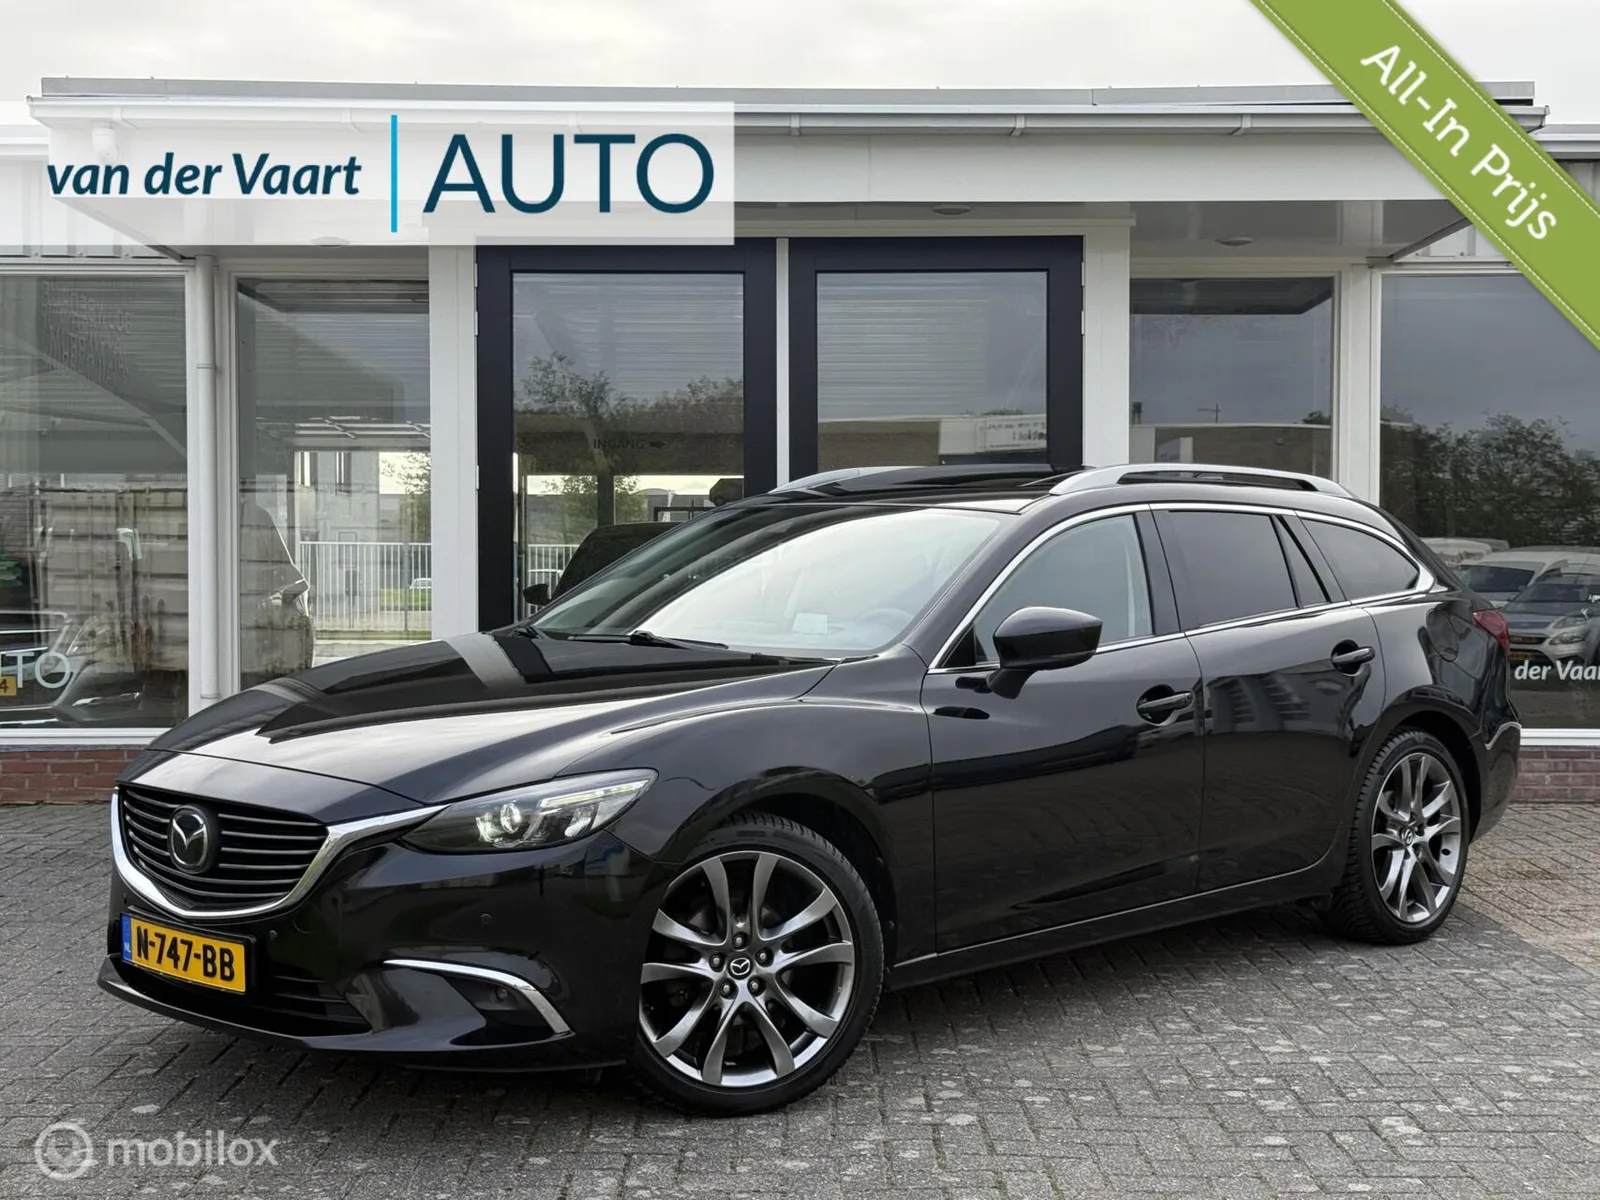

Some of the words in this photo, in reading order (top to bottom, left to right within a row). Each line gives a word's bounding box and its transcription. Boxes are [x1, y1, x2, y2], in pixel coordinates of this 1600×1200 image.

[0, 651, 71, 689] TO
[1514, 660, 1552, 680] der
[1556, 660, 1600, 680] Vaar
[136, 925, 235, 982] N-747-BB
